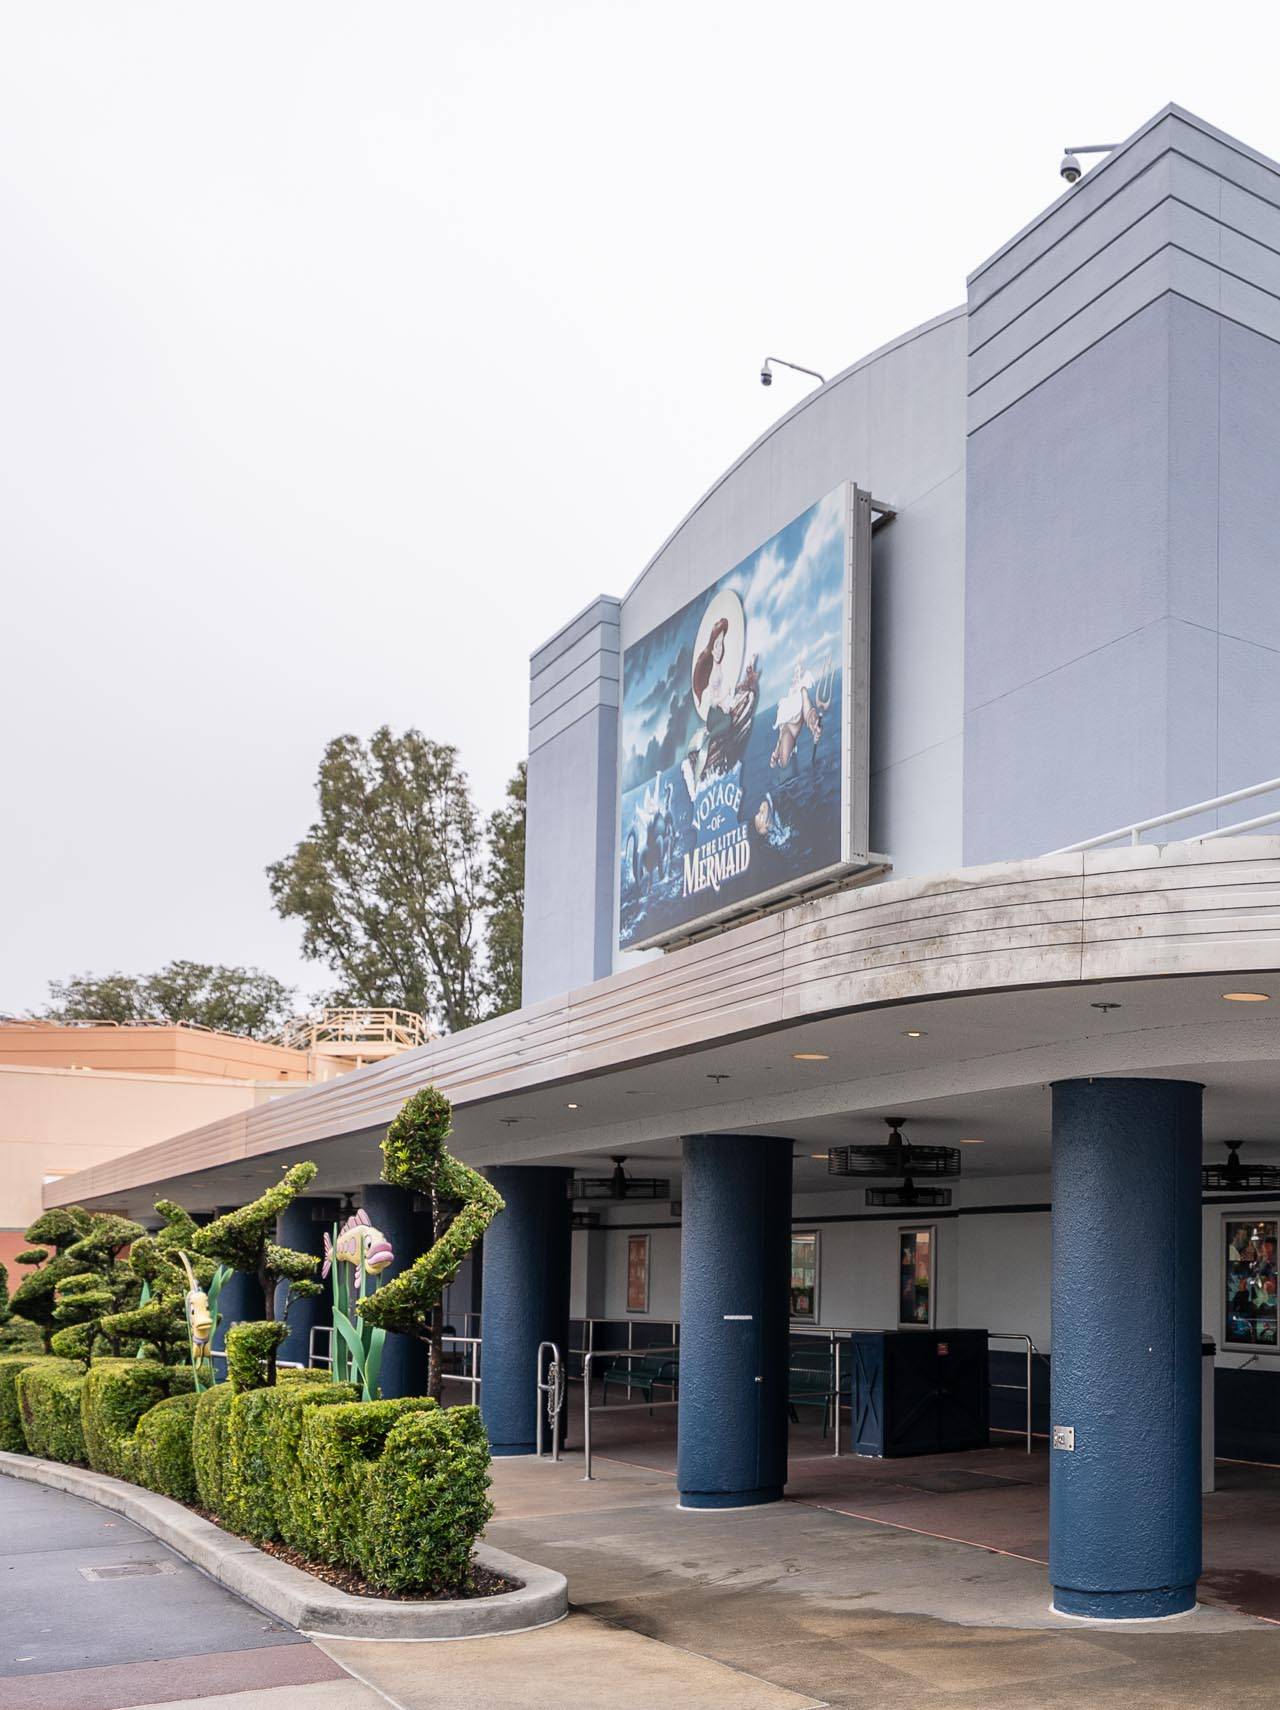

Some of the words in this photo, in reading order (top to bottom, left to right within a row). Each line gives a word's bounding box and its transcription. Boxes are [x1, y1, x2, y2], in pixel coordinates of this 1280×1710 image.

[692, 783, 743, 830] VOYAGE
[701, 839, 717, 859] THE
[717, 824, 748, 852] LITTLE
[683, 839, 750, 897] MERMAID
